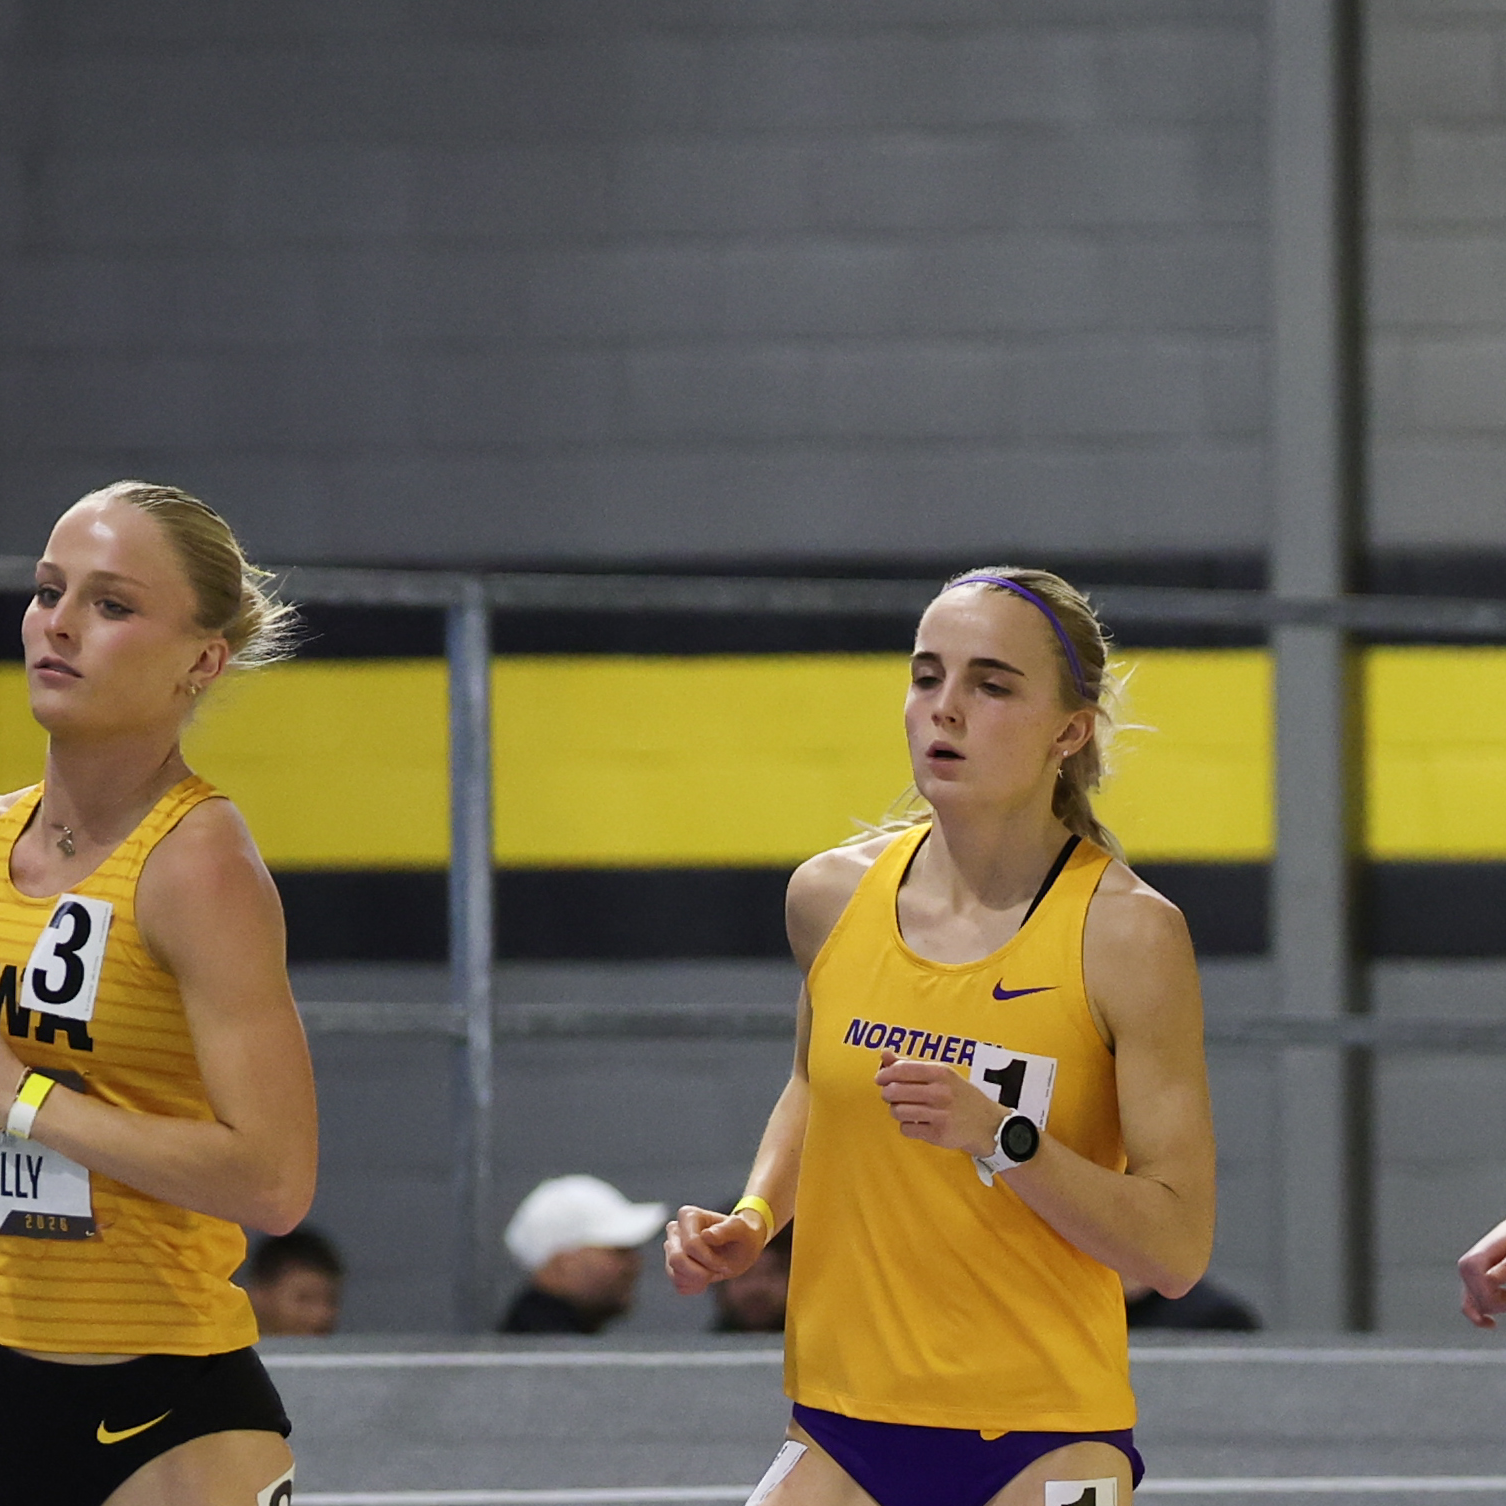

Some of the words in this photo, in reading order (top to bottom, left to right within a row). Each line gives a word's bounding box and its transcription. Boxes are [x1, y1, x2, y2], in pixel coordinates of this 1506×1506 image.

[31, 901, 92, 1005] 3
[843, 1018, 1003, 1067] NORTHER
[982, 1058, 1028, 1111] 1
